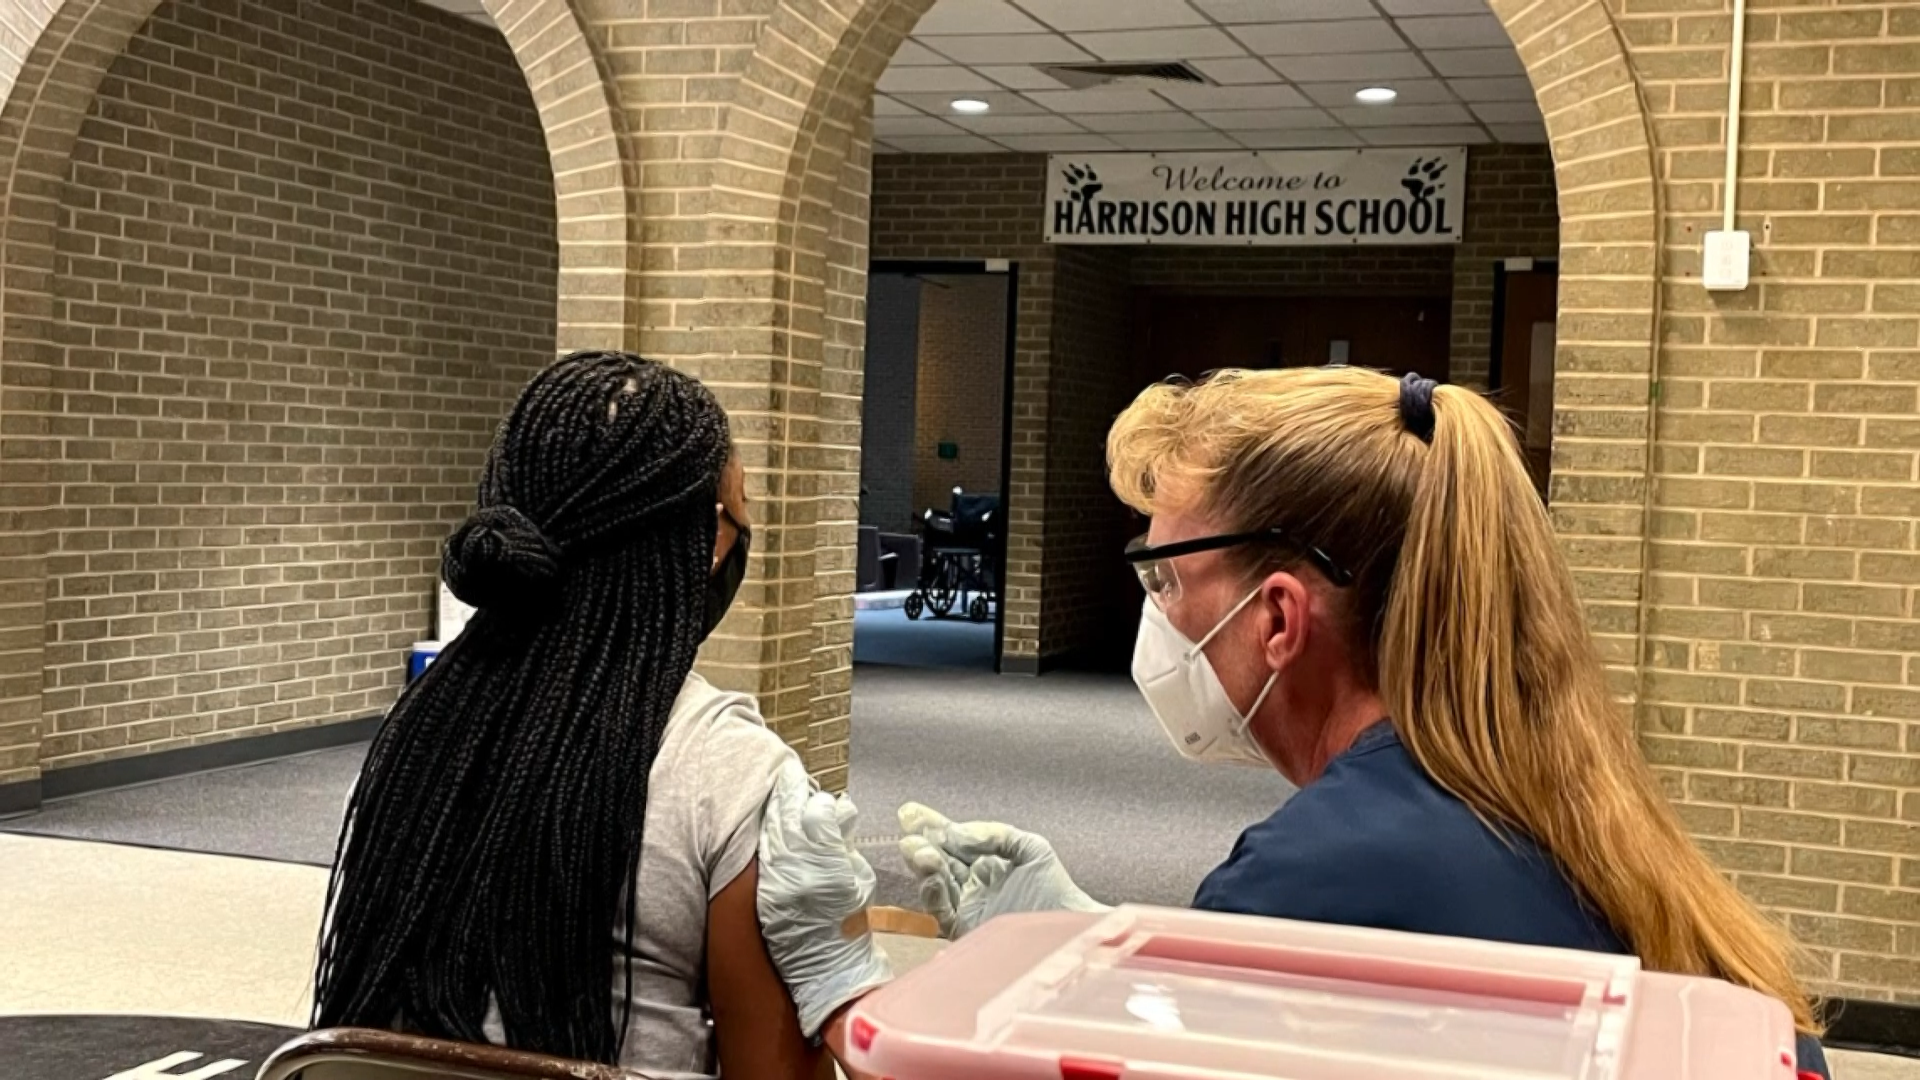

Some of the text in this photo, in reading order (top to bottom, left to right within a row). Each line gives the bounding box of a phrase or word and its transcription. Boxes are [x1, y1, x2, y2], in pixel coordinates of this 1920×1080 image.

[1152, 165, 1347, 191] Welcome to
[1053, 199, 1453, 235] HARRISON HIGH SCHOOL
